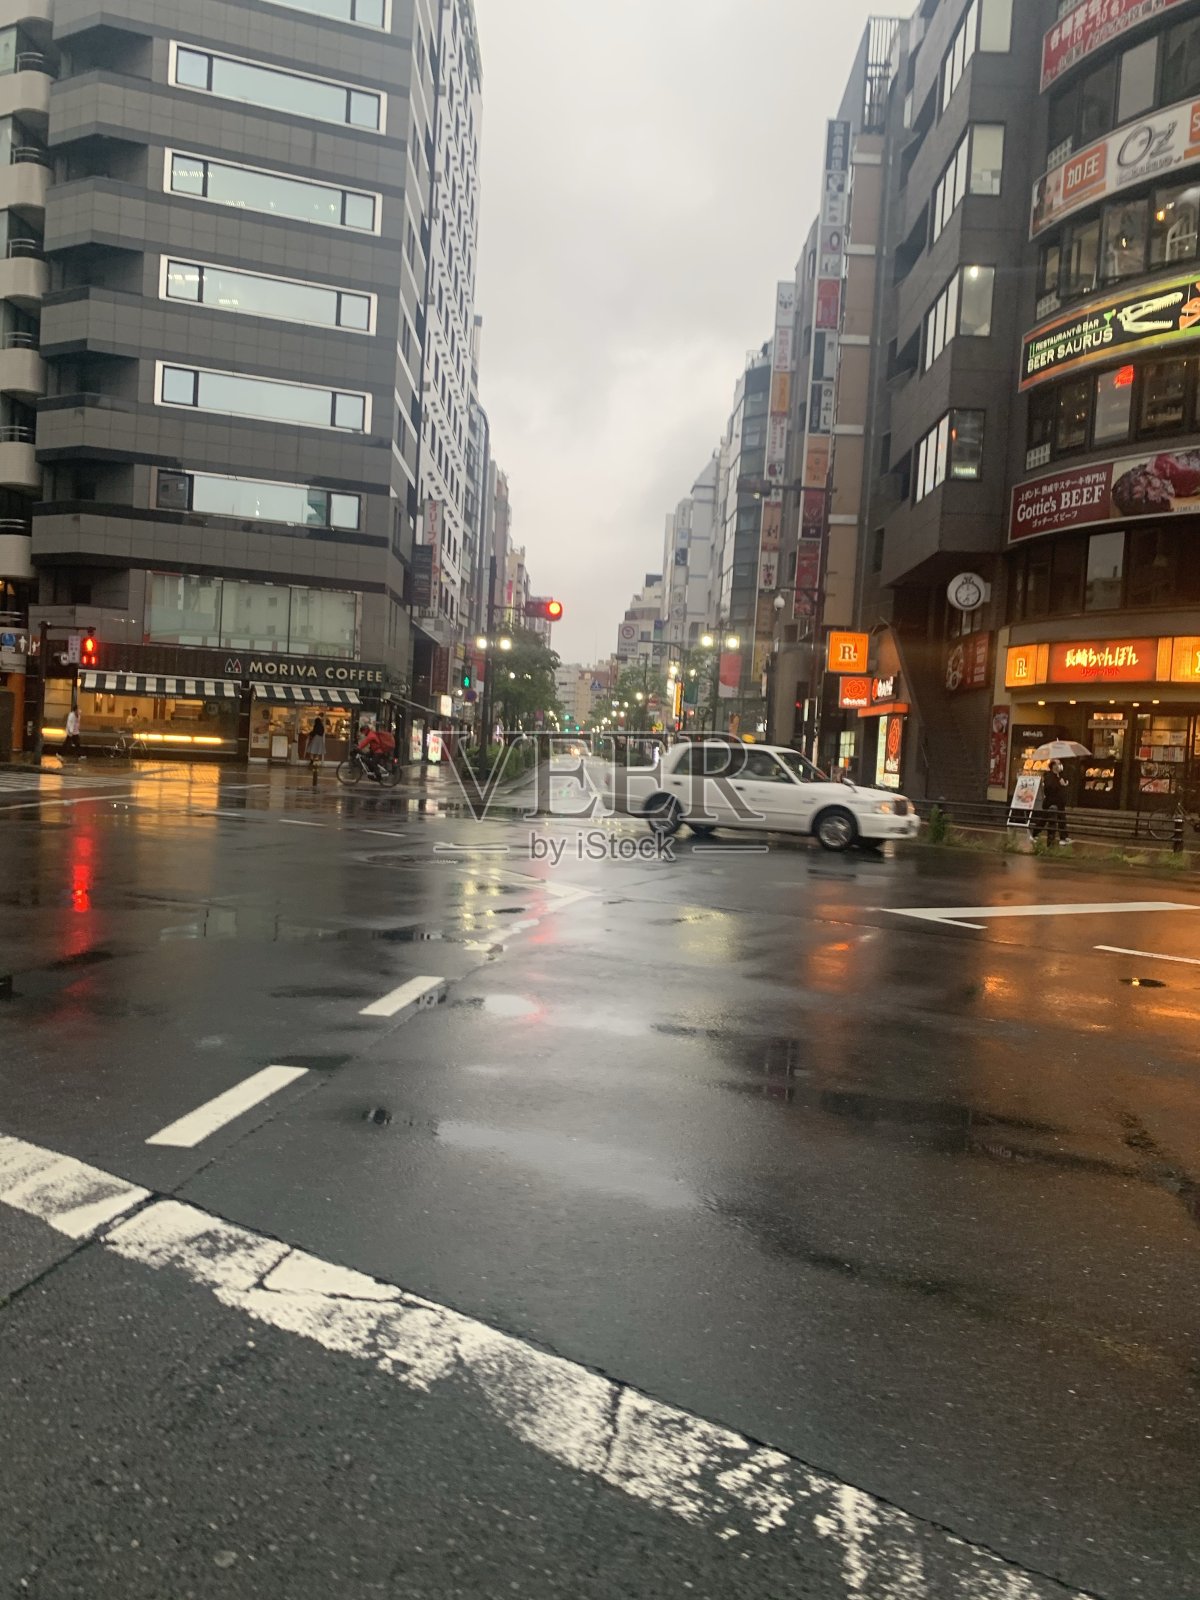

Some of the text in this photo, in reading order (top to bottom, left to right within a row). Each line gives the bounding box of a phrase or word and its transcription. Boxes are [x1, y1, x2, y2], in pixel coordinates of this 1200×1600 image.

[1067, 153, 1100, 189] 加圧
[1027, 327, 1113, 374] BEER SAURUS
[1016, 484, 1105, 522] Gottie's BEEF
[839, 643, 857, 662] R
[250, 661, 382, 682] MORIVA COFFEE
